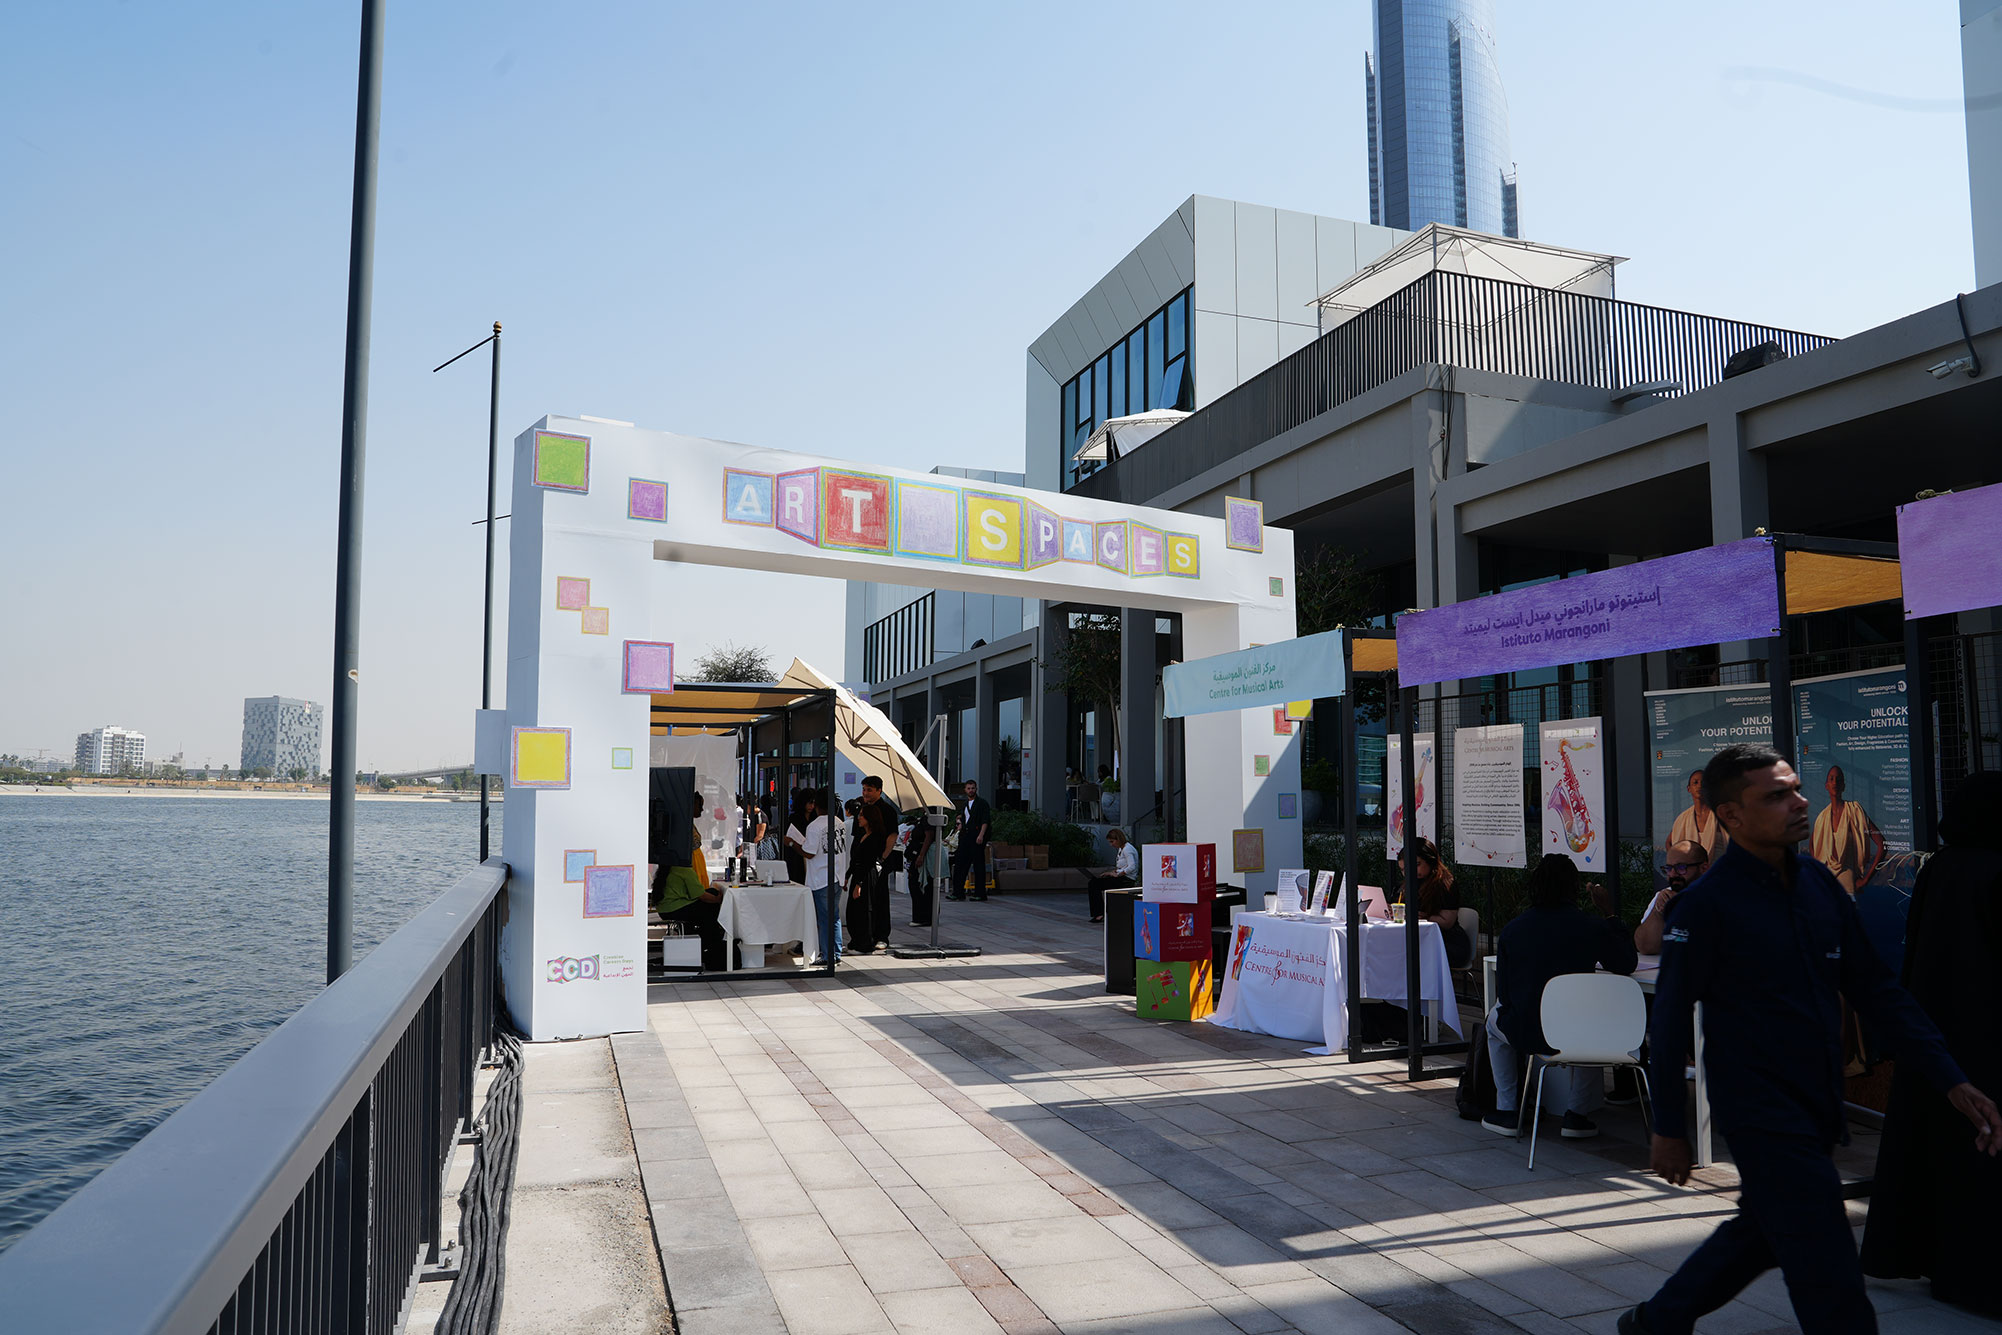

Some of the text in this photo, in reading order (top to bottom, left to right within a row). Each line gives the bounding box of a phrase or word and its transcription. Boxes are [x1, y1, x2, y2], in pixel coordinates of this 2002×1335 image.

[736, 484, 1191, 568] ART SPACES
[1525, 610, 1551, 628] ميدل
[1554, 600, 1605, 625] مارانجوني
[1463, 617, 1491, 637] ليميتد
[1501, 618, 1611, 648] Istituto Marangoni
[1213, 662, 1276, 684] مركز الفنون الموسيقية
[1209, 679, 1284, 699] Centre for Musical Arts
[1742, 715, 1773, 726] UNLO
[1870, 705, 1908, 717] UNLOCK
[1700, 726, 1773, 737] YOUR POTENTI
[1837, 717, 1909, 730] YOUR POTENTIAL
[547, 957, 597, 982] CCD
[1245, 960, 1272, 975] CENTRE
